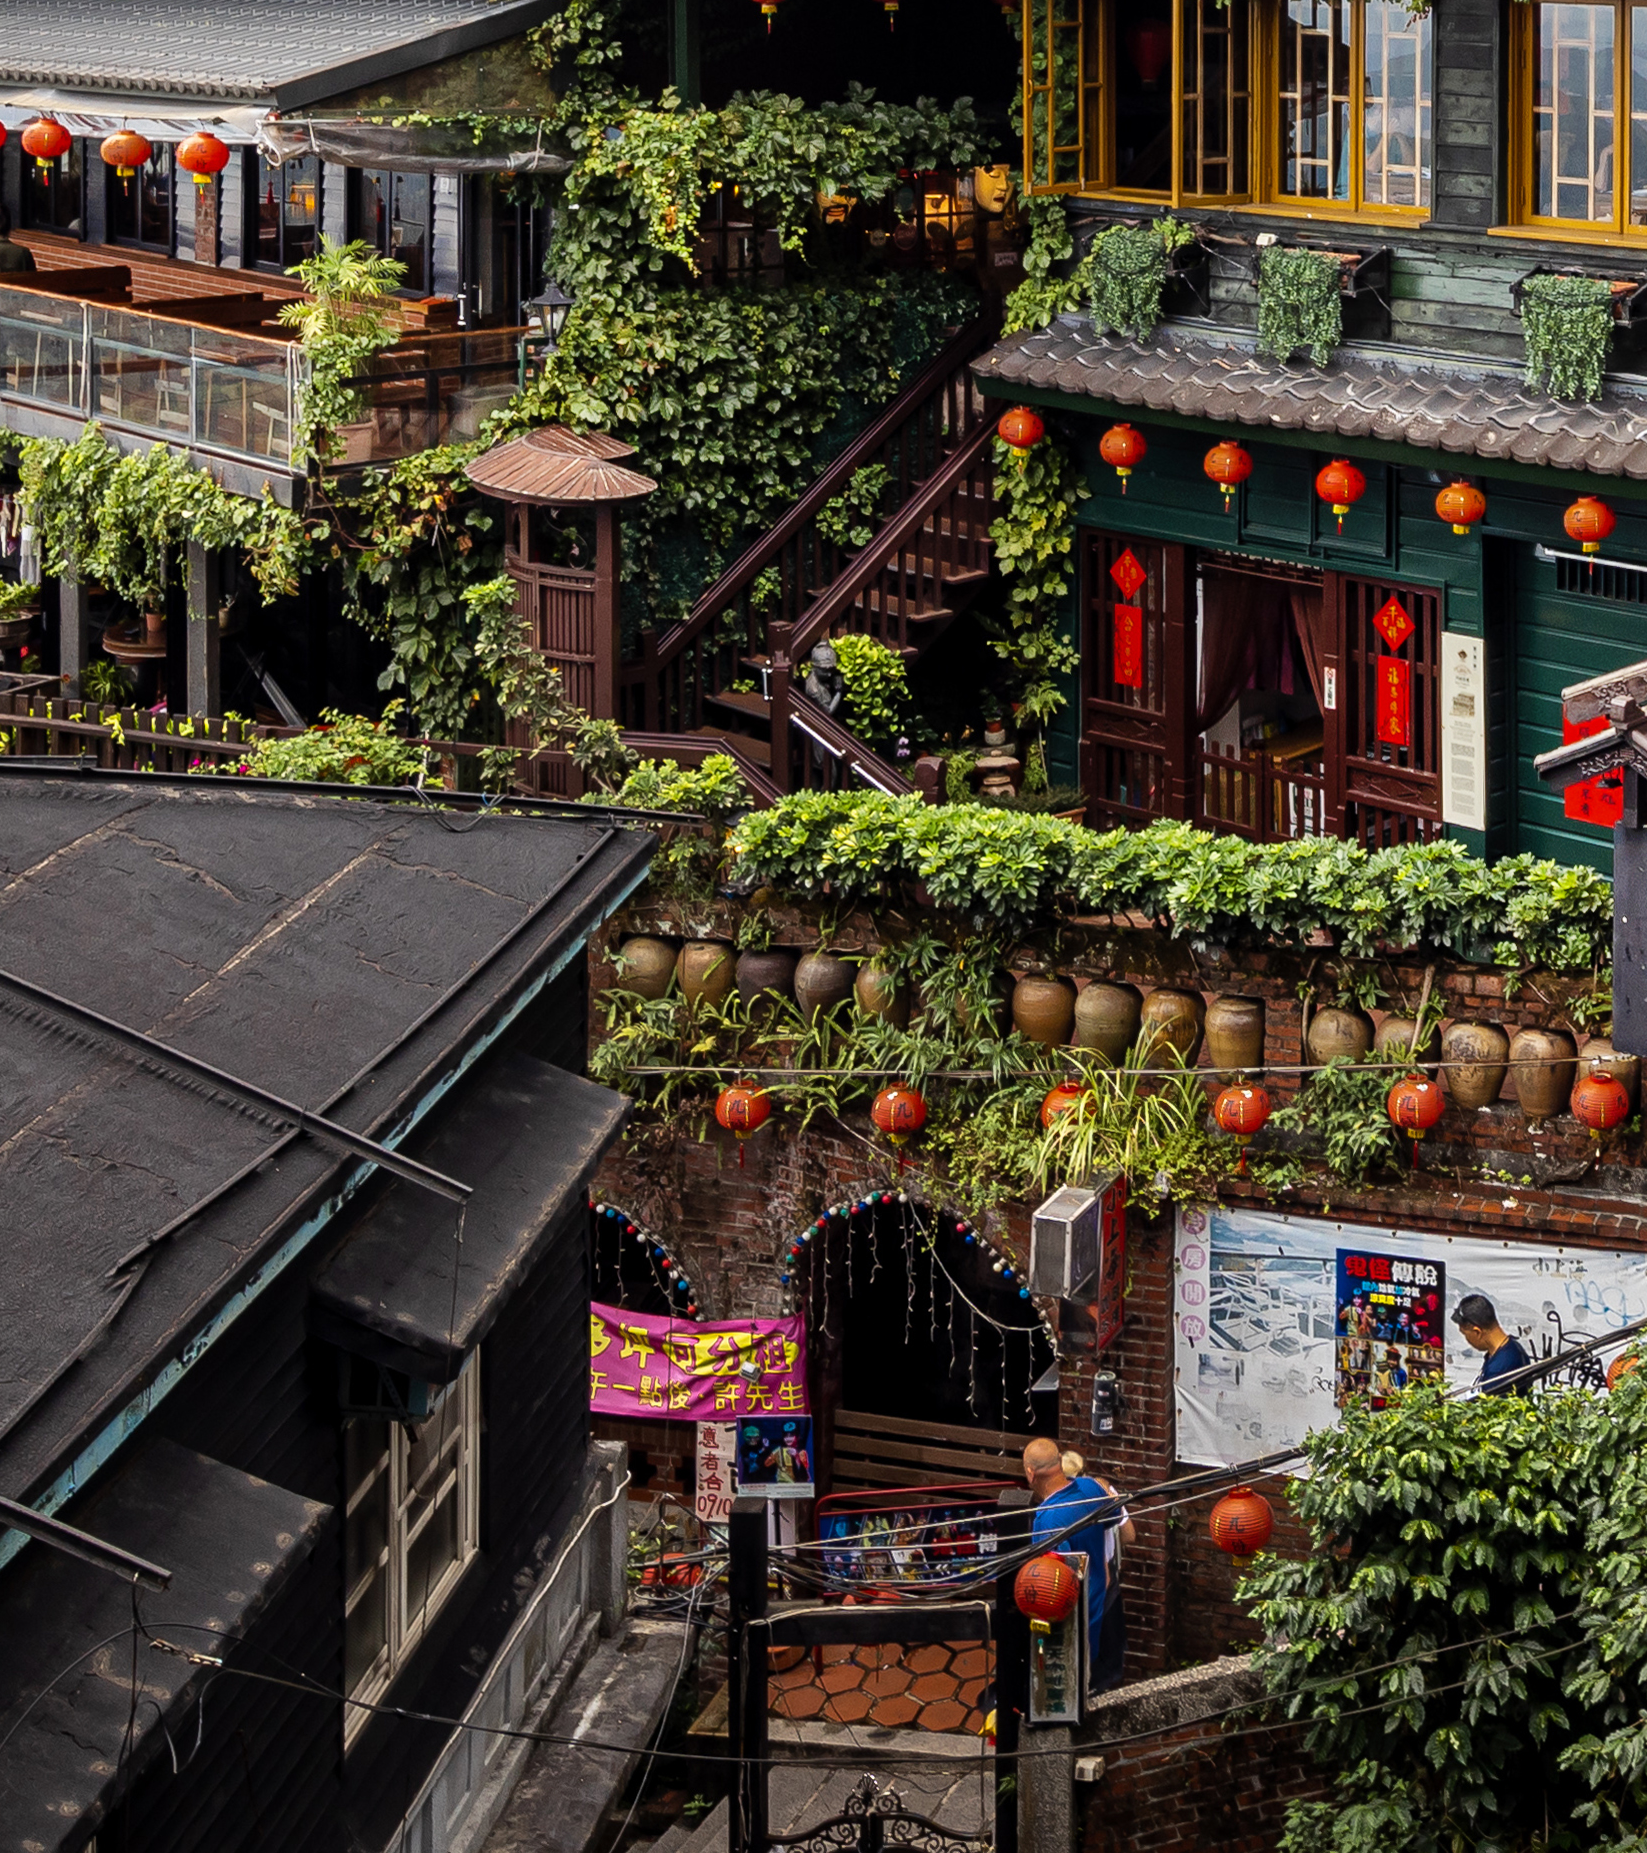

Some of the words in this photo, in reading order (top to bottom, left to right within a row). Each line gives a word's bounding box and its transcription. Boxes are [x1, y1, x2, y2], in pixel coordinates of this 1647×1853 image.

[1345, 1255, 1438, 1287] 鬼怪傳說
[1226, 1515, 1247, 1554] 九份
[1023, 1563, 1041, 1603] 九份
